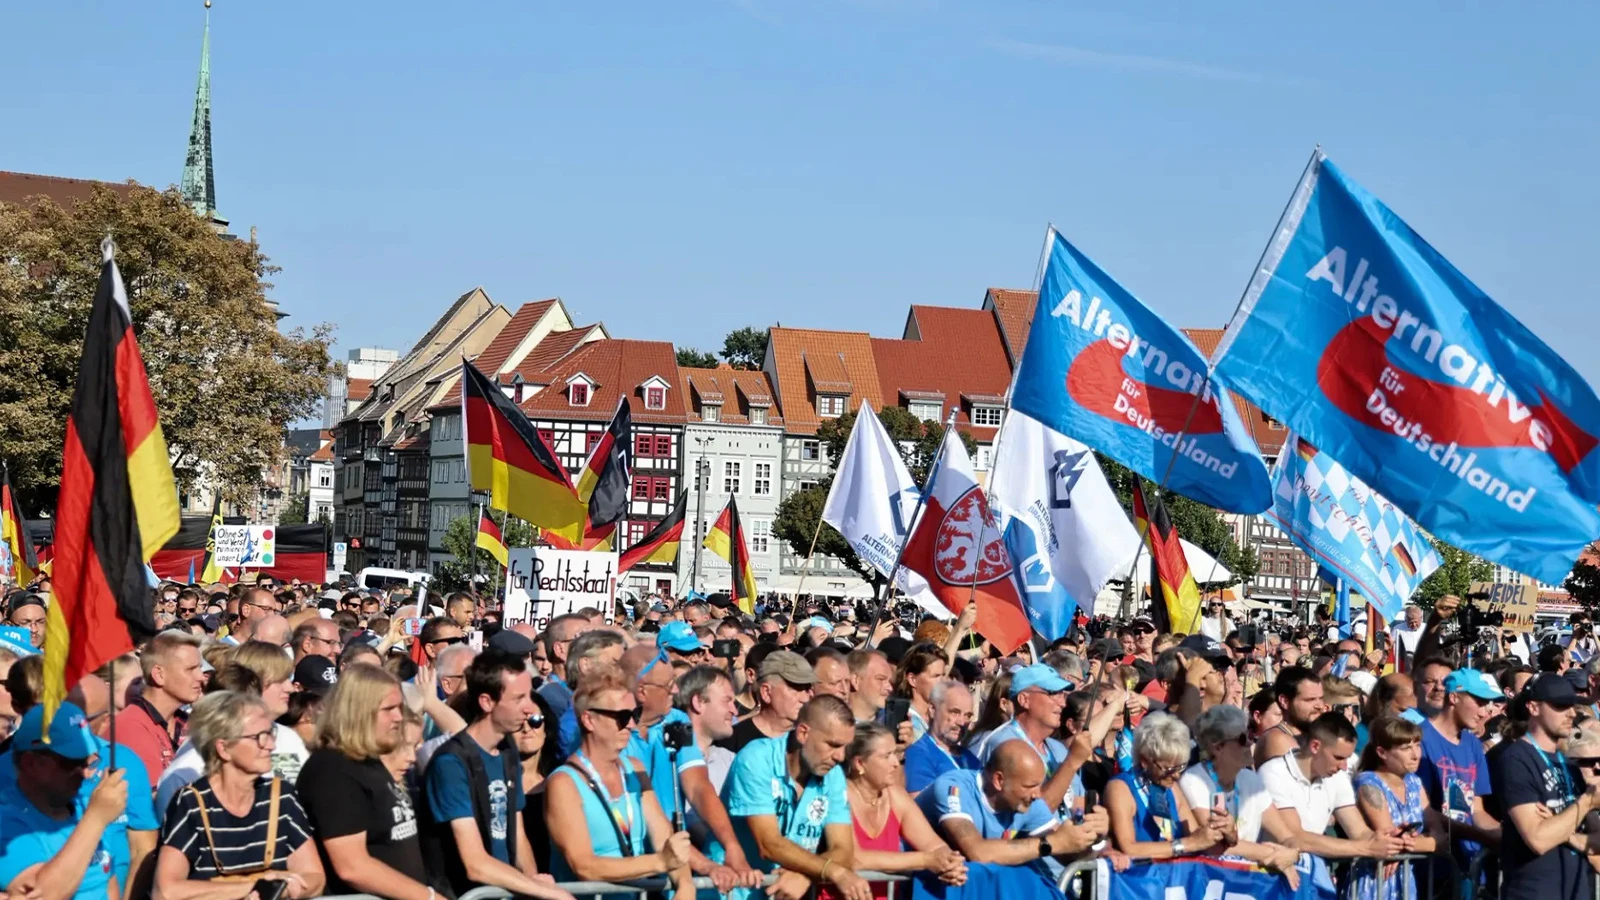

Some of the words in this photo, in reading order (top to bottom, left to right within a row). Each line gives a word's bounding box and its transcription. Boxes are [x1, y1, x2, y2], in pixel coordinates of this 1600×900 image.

[1051, 289, 1212, 404] Alternati
[1305, 245, 1553, 451] Alternative
[1121, 378, 1141, 400] für
[1379, 367, 1404, 396] für
[1113, 394, 1238, 480] Deutschland
[1366, 388, 1537, 513] Deutschland
[879, 533, 902, 553] JUNG
[510, 560, 528, 595] für
[1479, 583, 1527, 605] WEIDEL
